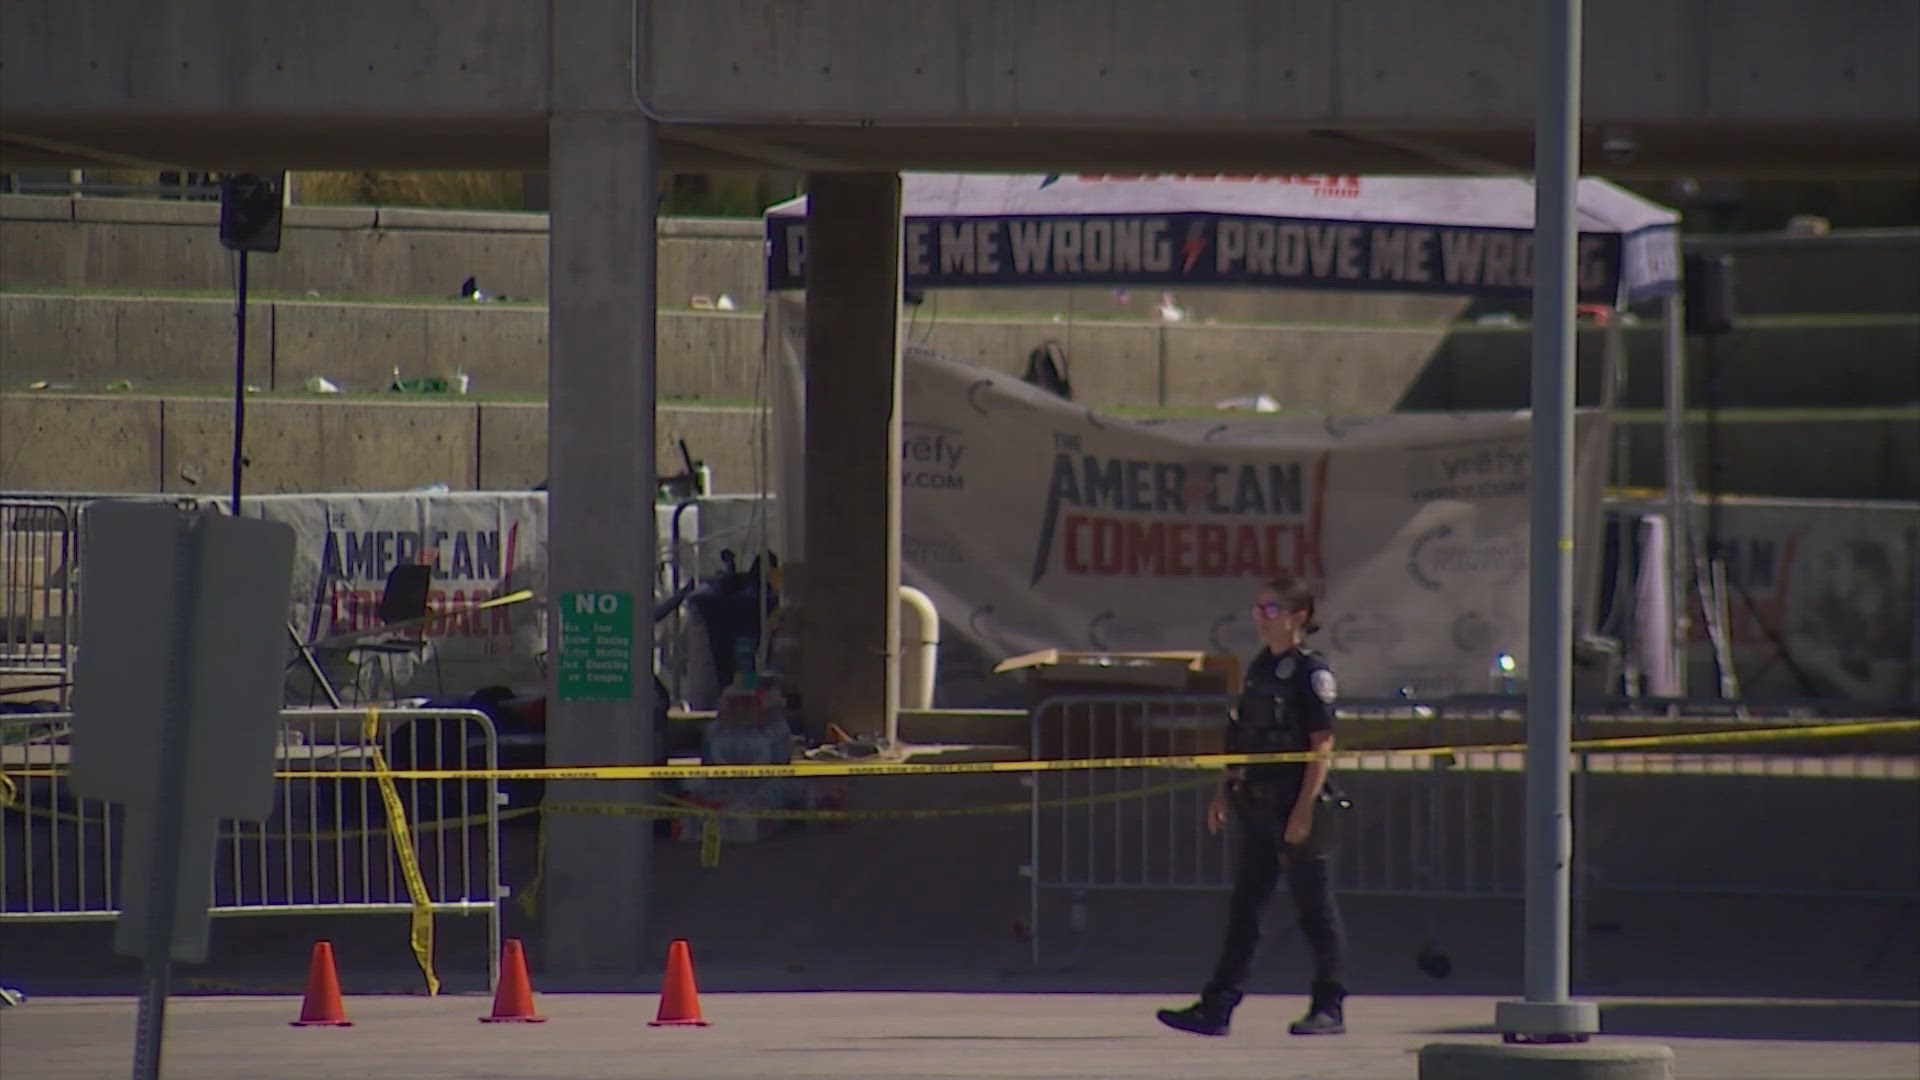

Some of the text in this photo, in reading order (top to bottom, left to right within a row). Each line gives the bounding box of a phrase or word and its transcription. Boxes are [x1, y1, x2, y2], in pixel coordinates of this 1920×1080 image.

[941, 222, 1001, 275] ME
[1009, 219, 1171, 275] WRONG
[1216, 220, 1361, 280] PROVE
[1370, 227, 1434, 283] ME
[1440, 229, 1607, 291] WROG
[1054, 433, 1082, 453] THE
[1050, 453, 1303, 518] AMERCAN
[322, 531, 500, 582] AMERCAN
[1064, 514, 1325, 578] COMEBACK
[575, 593, 618, 615] NO
